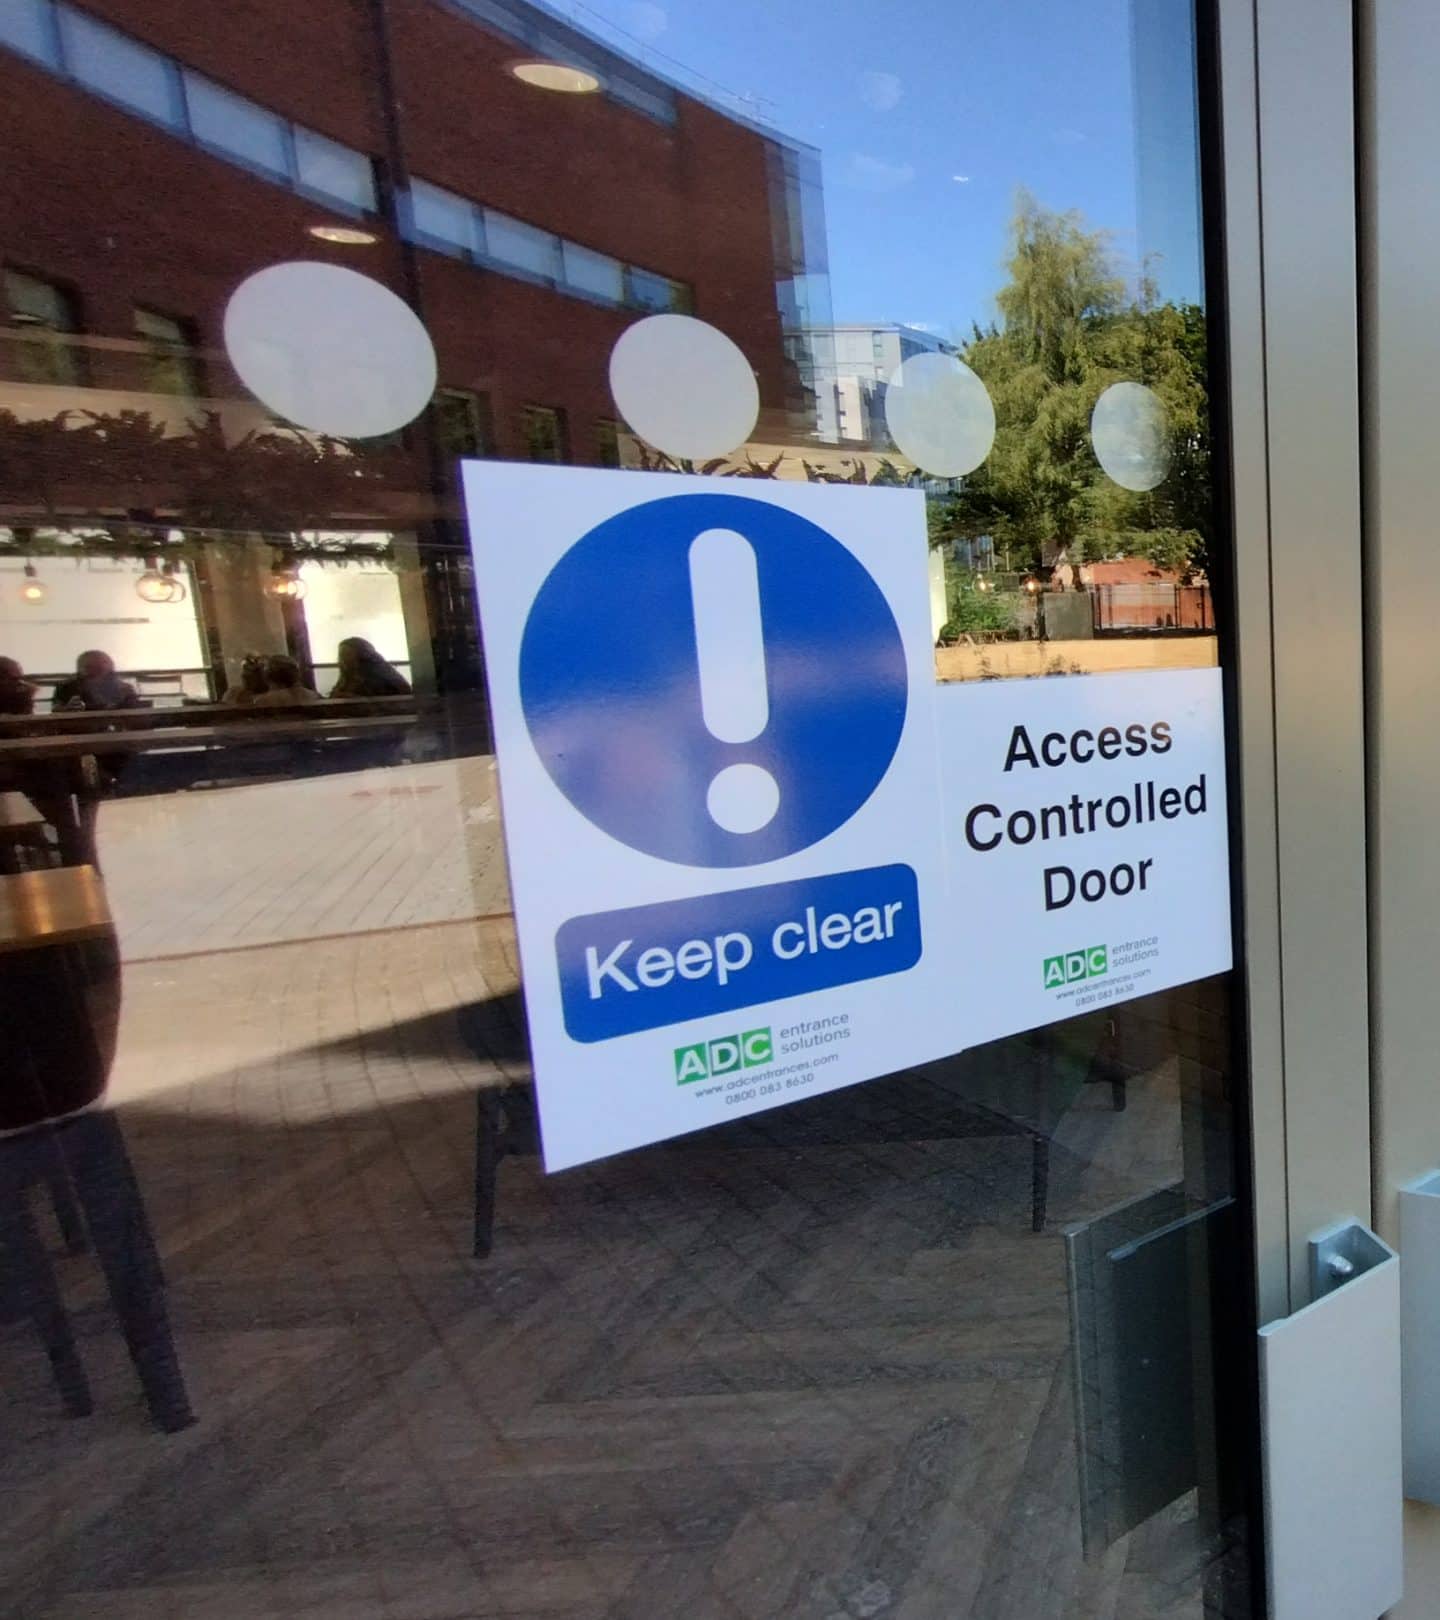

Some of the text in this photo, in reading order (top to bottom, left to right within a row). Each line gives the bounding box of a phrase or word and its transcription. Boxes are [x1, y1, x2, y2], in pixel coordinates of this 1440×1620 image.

[1003, 721, 1172, 772] Access
[965, 774, 1207, 851] Controlled
[1044, 858, 1152, 912] Door
[585, 901, 903, 1000] Keep clear
[1044, 946, 1107, 989] ADC
[1112, 936, 1158, 955] entrance
[1112, 948, 1159, 968] solutions
[780, 1013, 849, 1039] entrance
[780, 1027, 851, 1055] solutions
[675, 1029, 773, 1084] ADC
[695, 1053, 839, 1098] www.adcentrances.com
[725, 1073, 815, 1105] 0800 083 8630
